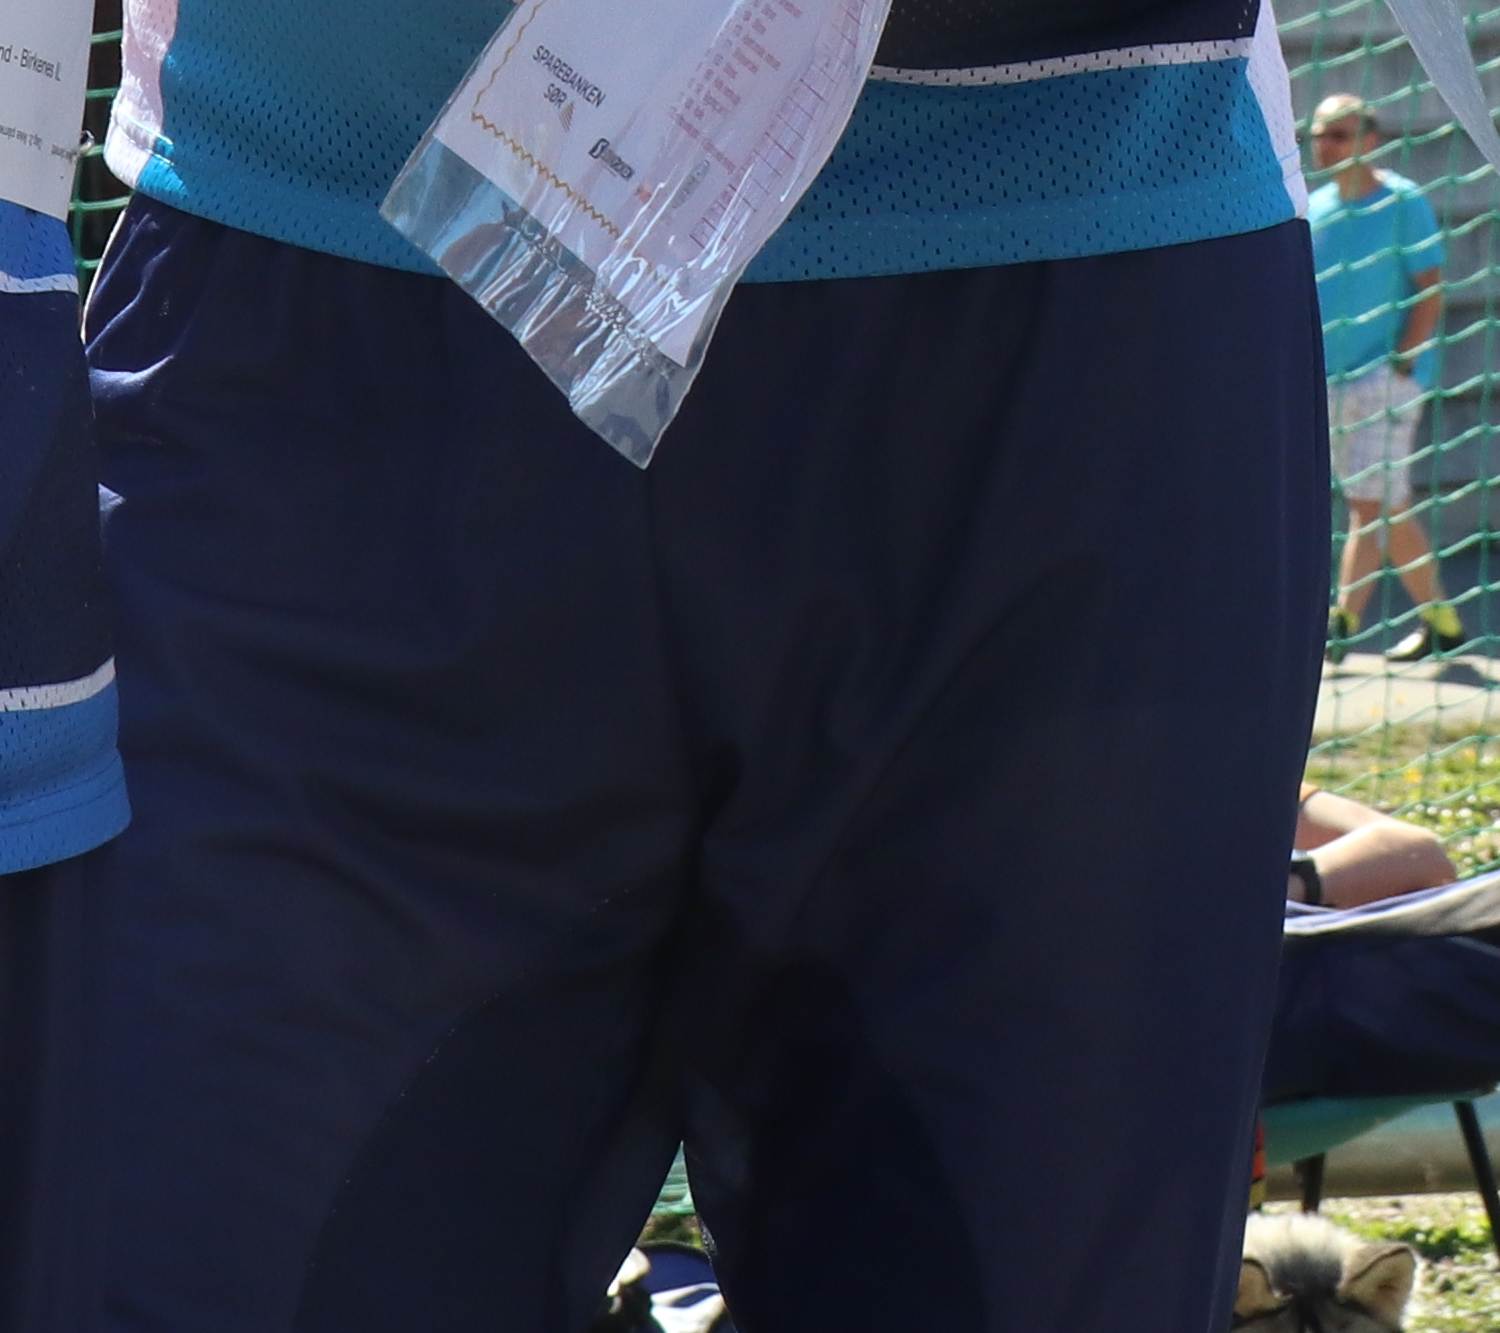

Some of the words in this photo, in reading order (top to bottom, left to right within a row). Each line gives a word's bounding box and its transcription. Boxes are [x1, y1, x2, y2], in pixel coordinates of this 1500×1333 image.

[20, 47, 55, 79] Birkenes
[532, 44, 607, 109] SPAREBANKEN
[543, 82, 568, 109] SØR
